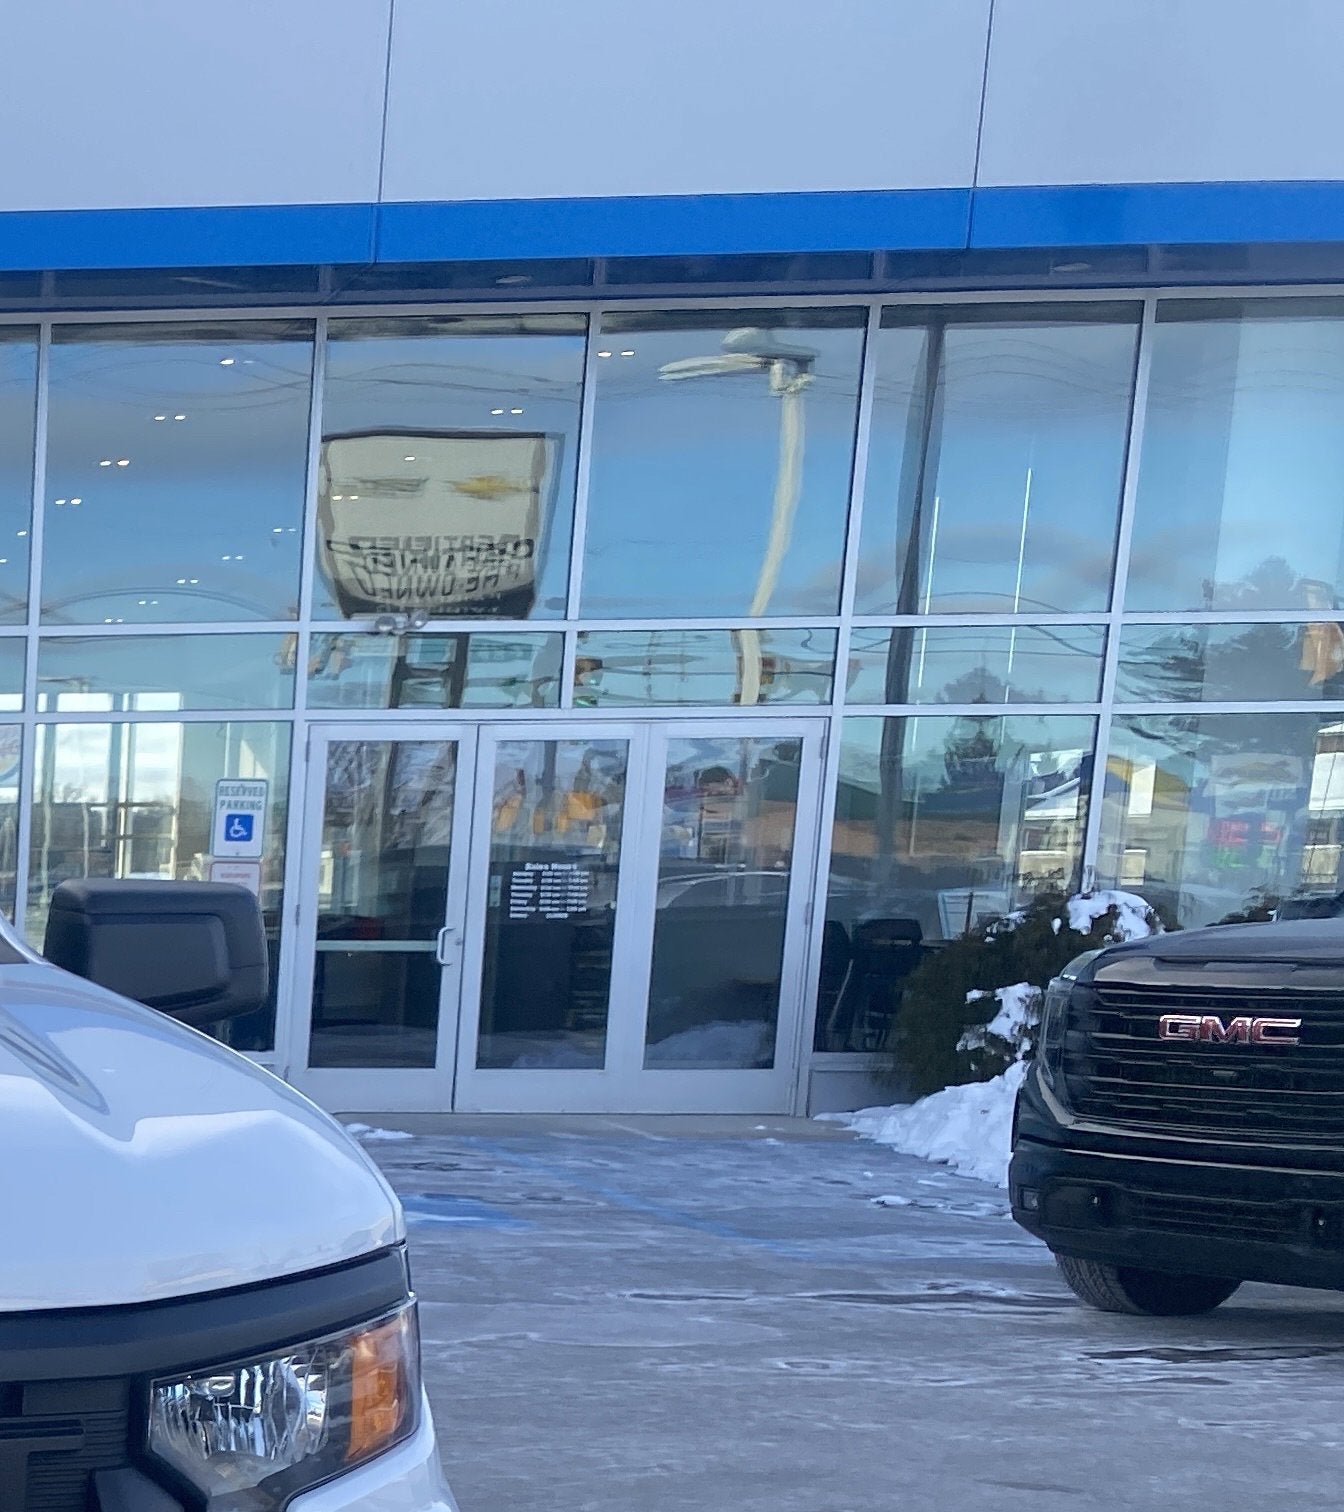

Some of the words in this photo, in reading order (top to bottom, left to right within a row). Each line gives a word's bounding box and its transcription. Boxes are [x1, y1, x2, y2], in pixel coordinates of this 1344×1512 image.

[218, 786, 265, 797] RESERVED
[219, 800, 263, 811] PARKING
[1159, 1014, 1302, 1045] GMC
